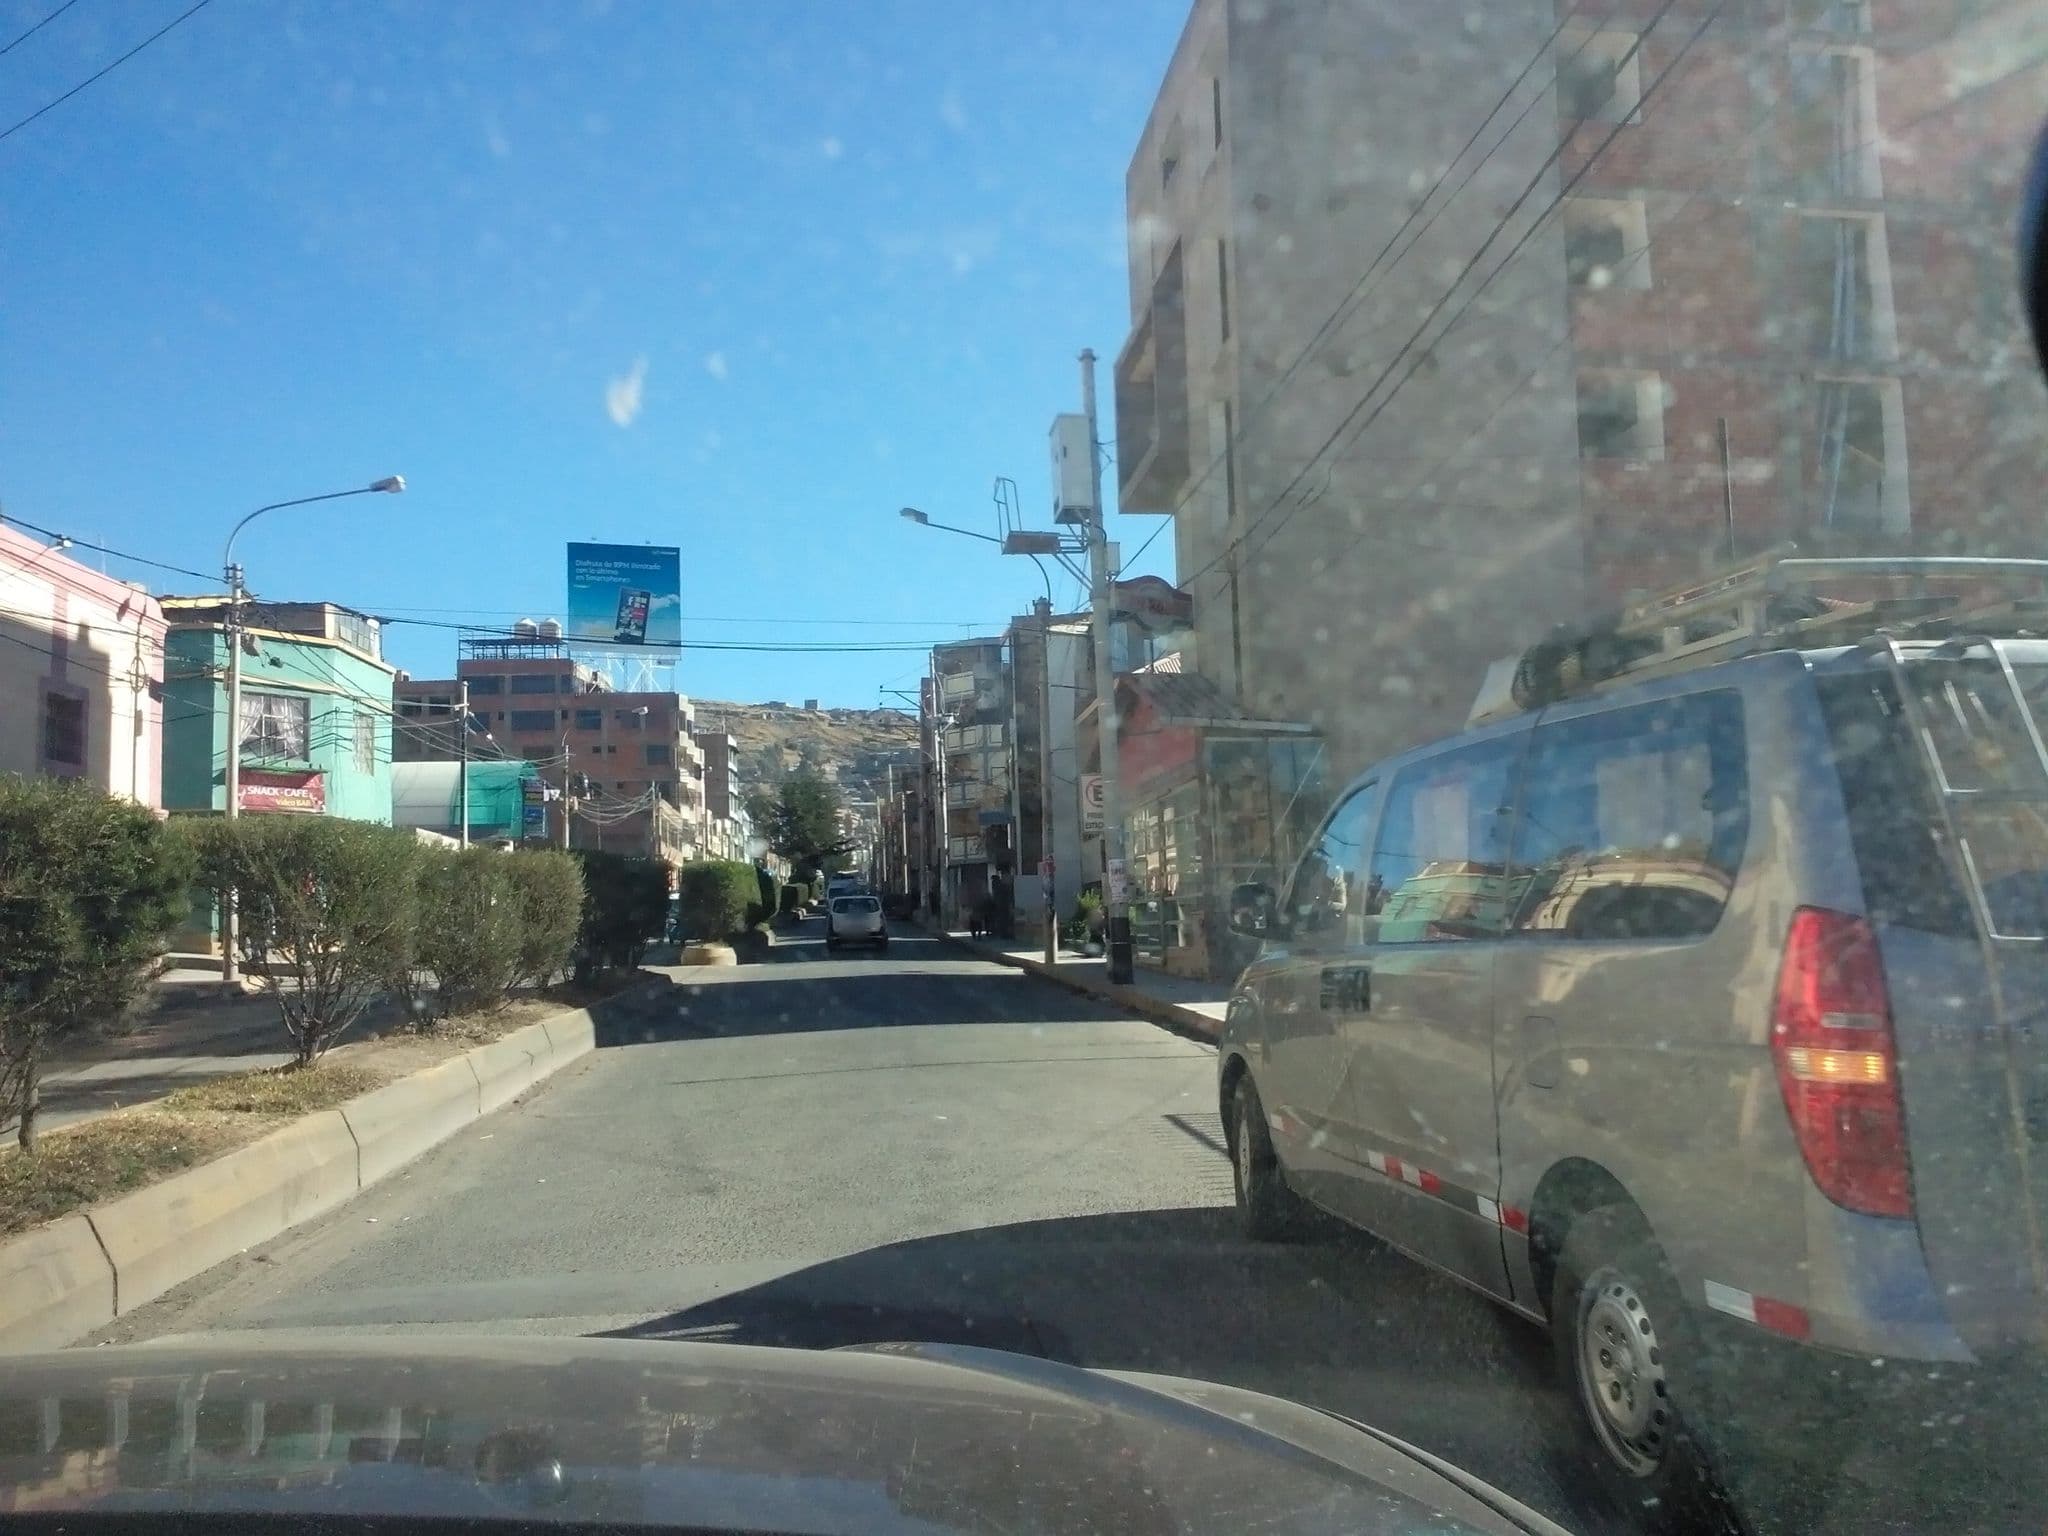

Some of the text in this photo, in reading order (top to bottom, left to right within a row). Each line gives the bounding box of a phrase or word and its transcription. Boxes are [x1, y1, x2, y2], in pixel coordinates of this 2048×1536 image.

[247, 785, 308, 797] SNACK CAFE
[275, 798, 296, 806] Video
